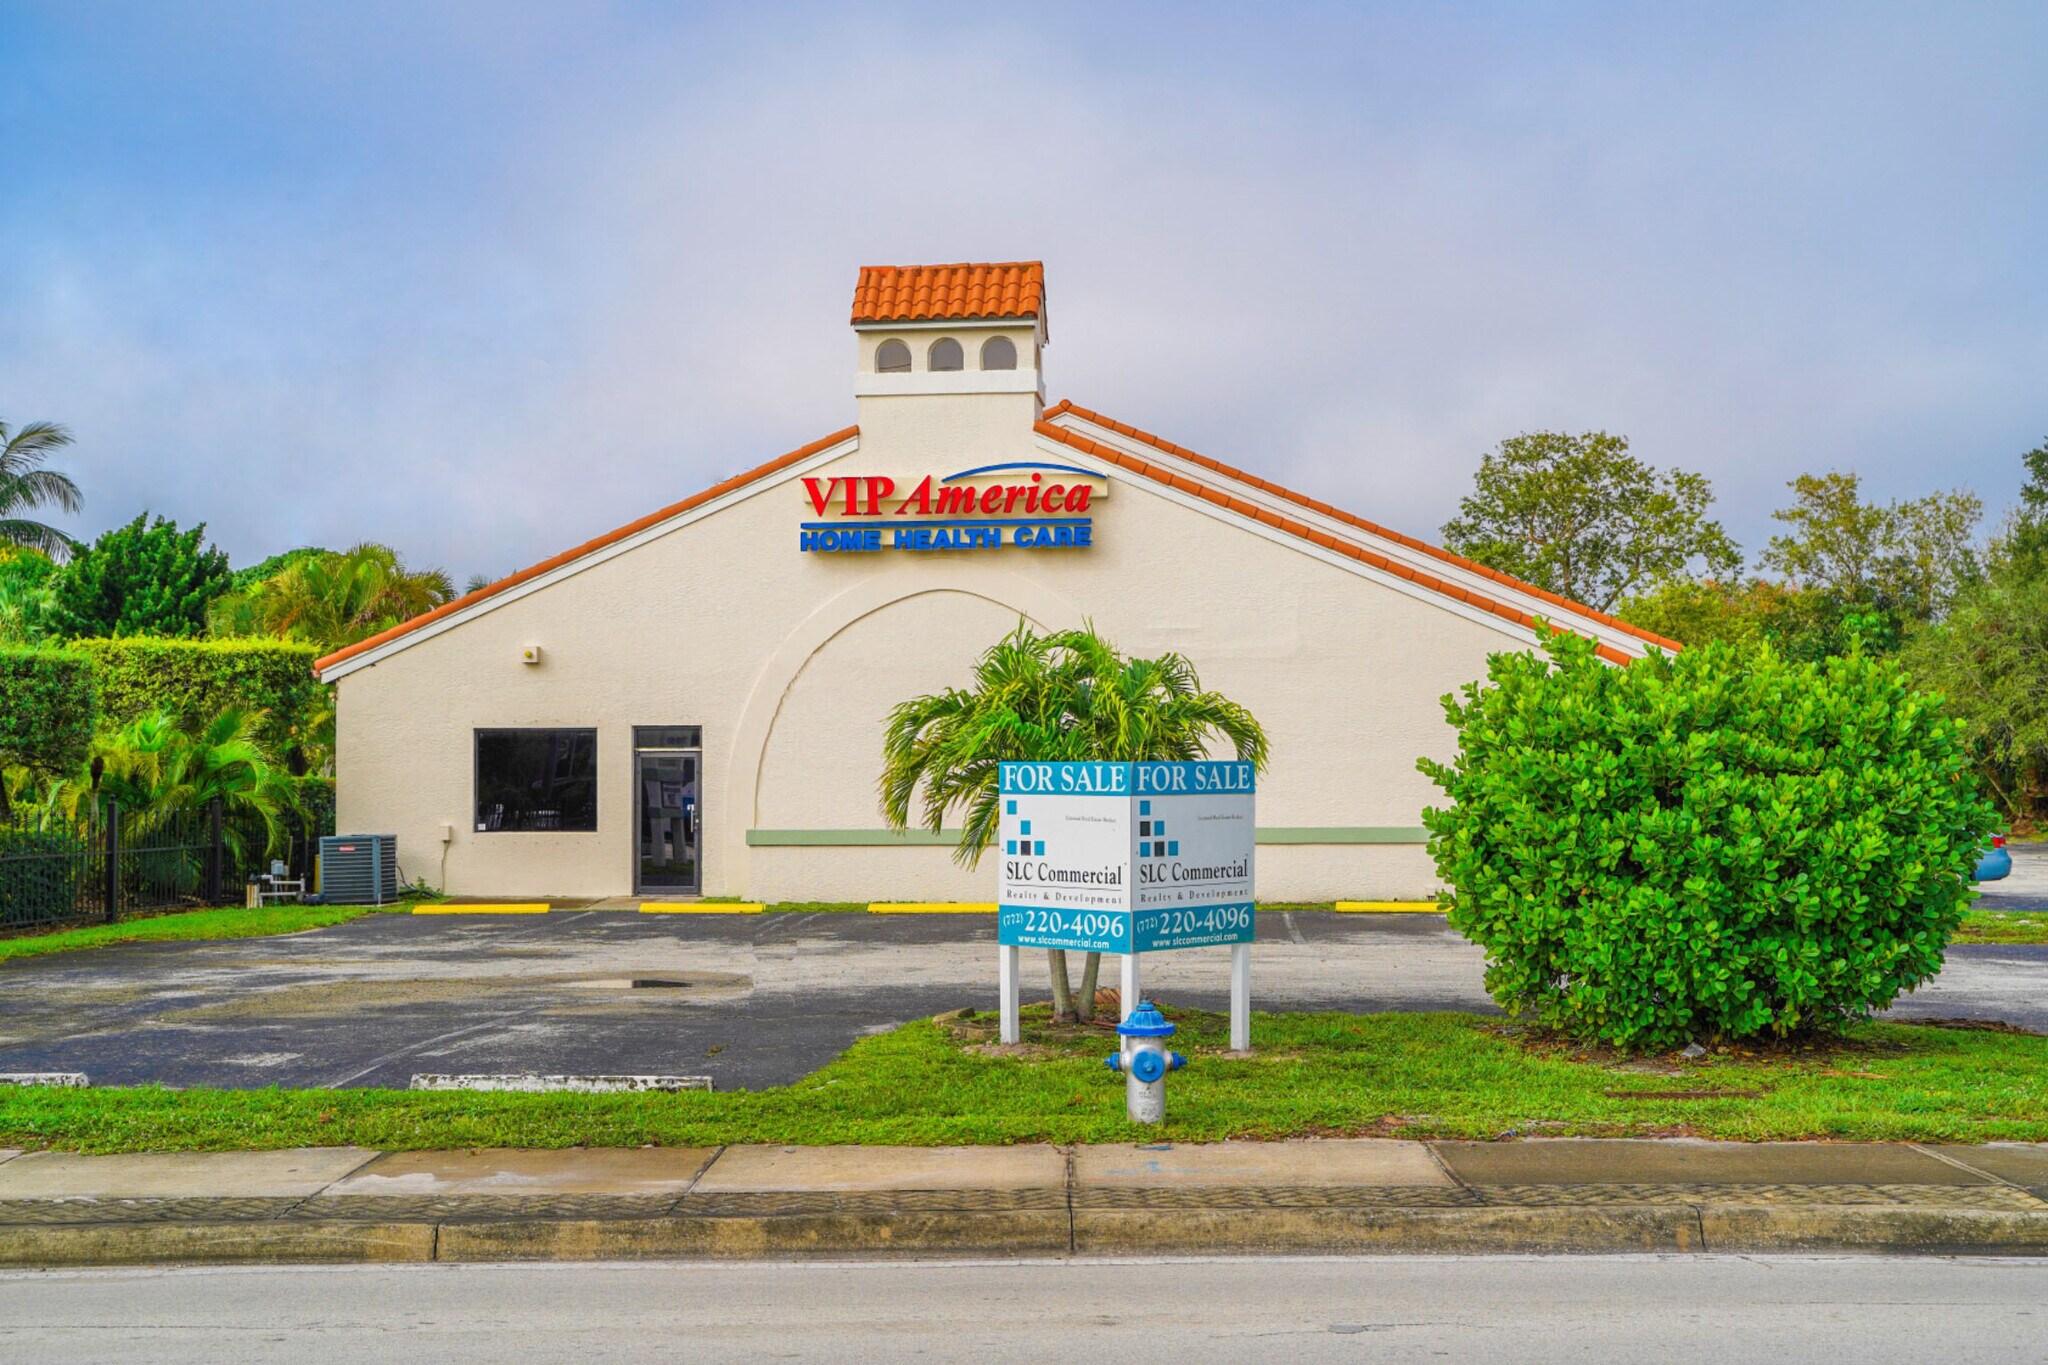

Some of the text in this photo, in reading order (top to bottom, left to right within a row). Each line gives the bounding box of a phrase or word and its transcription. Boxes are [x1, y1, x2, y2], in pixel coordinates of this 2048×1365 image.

[801, 473, 1092, 517] VIP America
[800, 526, 1092, 551] HOME HEALTH CARE
[1003, 765, 1126, 792] FOR SALE
[1137, 765, 1250, 791] FOR SALE
[1006, 861, 1122, 885] SLC Commercial
[1140, 859, 1248, 883] SLC Commercial
[1043, 891, 1050, 901] &
[1056, 891, 1122, 905] Development
[1177, 891, 1184, 900] &
[1189, 888, 1248, 900] Development
[1003, 910, 1124, 938] (772) 220-4096
[1136, 906, 1250, 935] (772) 220-4096
[1018, 935, 1109, 949] www.slccommercial.com
[1152, 933, 1239, 948] wwwslccommercial.com
